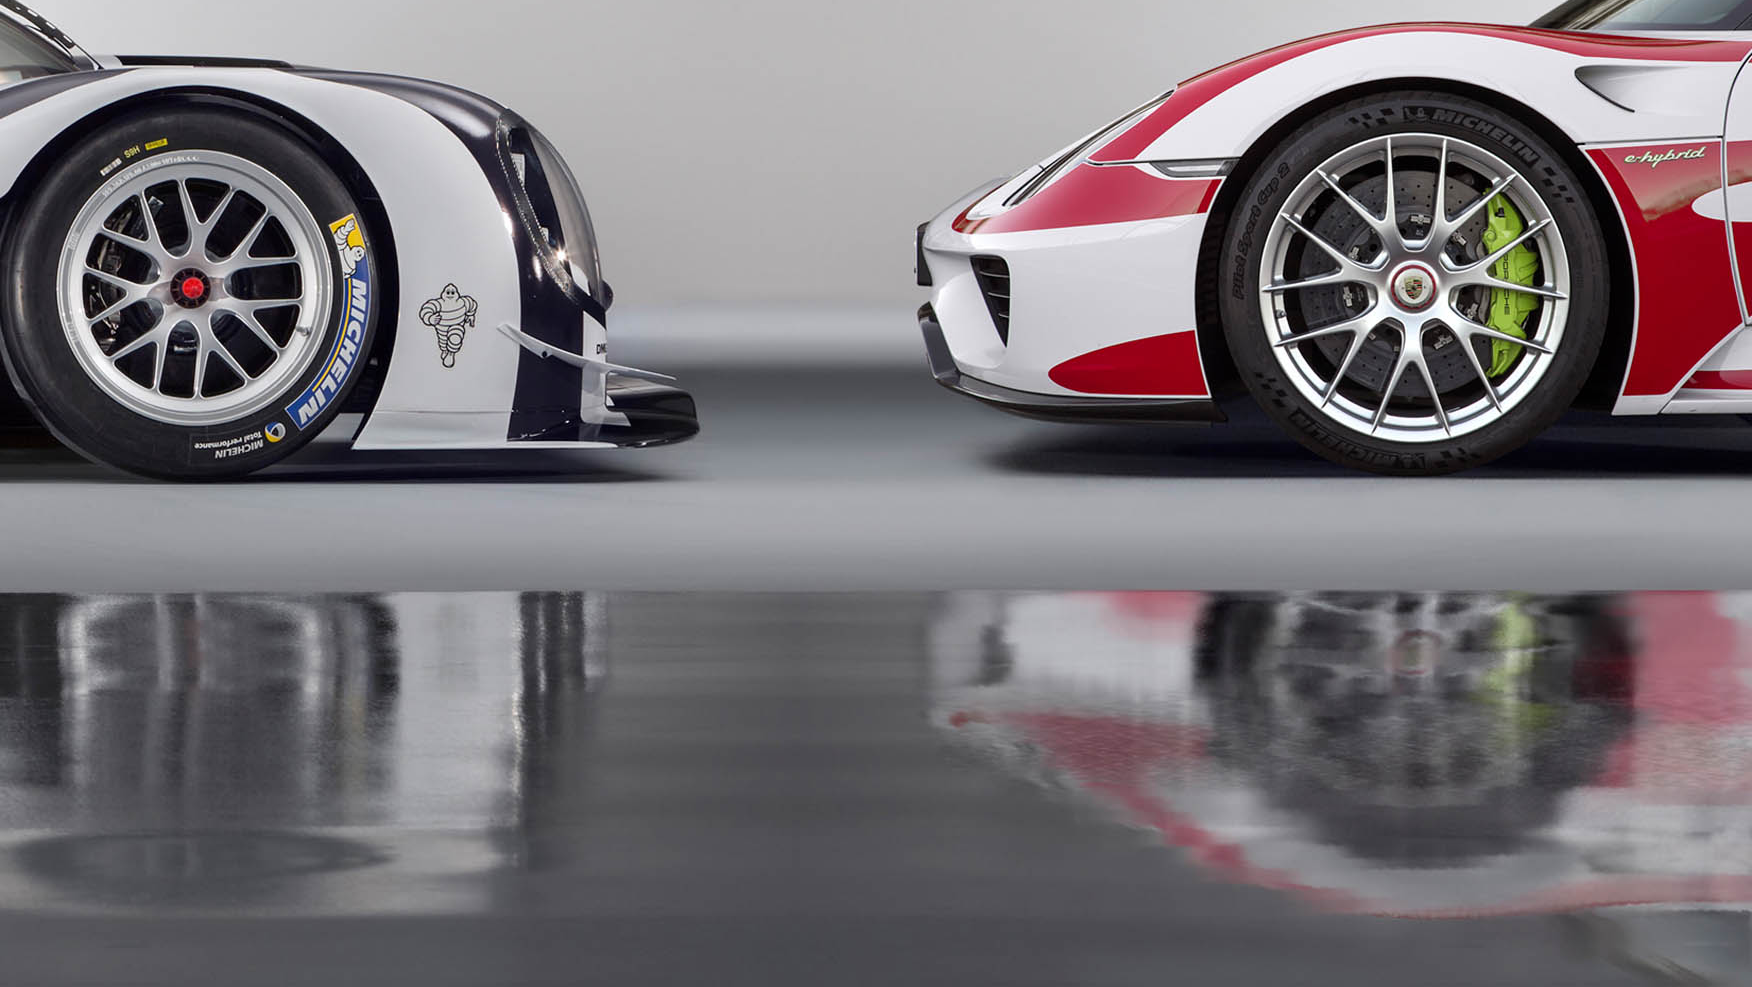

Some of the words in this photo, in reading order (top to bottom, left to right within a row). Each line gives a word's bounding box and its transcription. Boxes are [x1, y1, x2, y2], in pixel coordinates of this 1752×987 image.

[1431, 108, 1541, 166] MICHELIN
[1623, 146, 1707, 168] e-hybrid
[1277, 162, 1291, 181] 2
[1257, 175, 1281, 206] Cup
[1237, 204, 1260, 255] Sport
[1232, 254, 1246, 300] Pilot
[298, 279, 367, 424] MICHELIN
[194, 436, 243, 449] Performance
[214, 439, 264, 458] MICHELIN
[243, 431, 263, 443] Total
